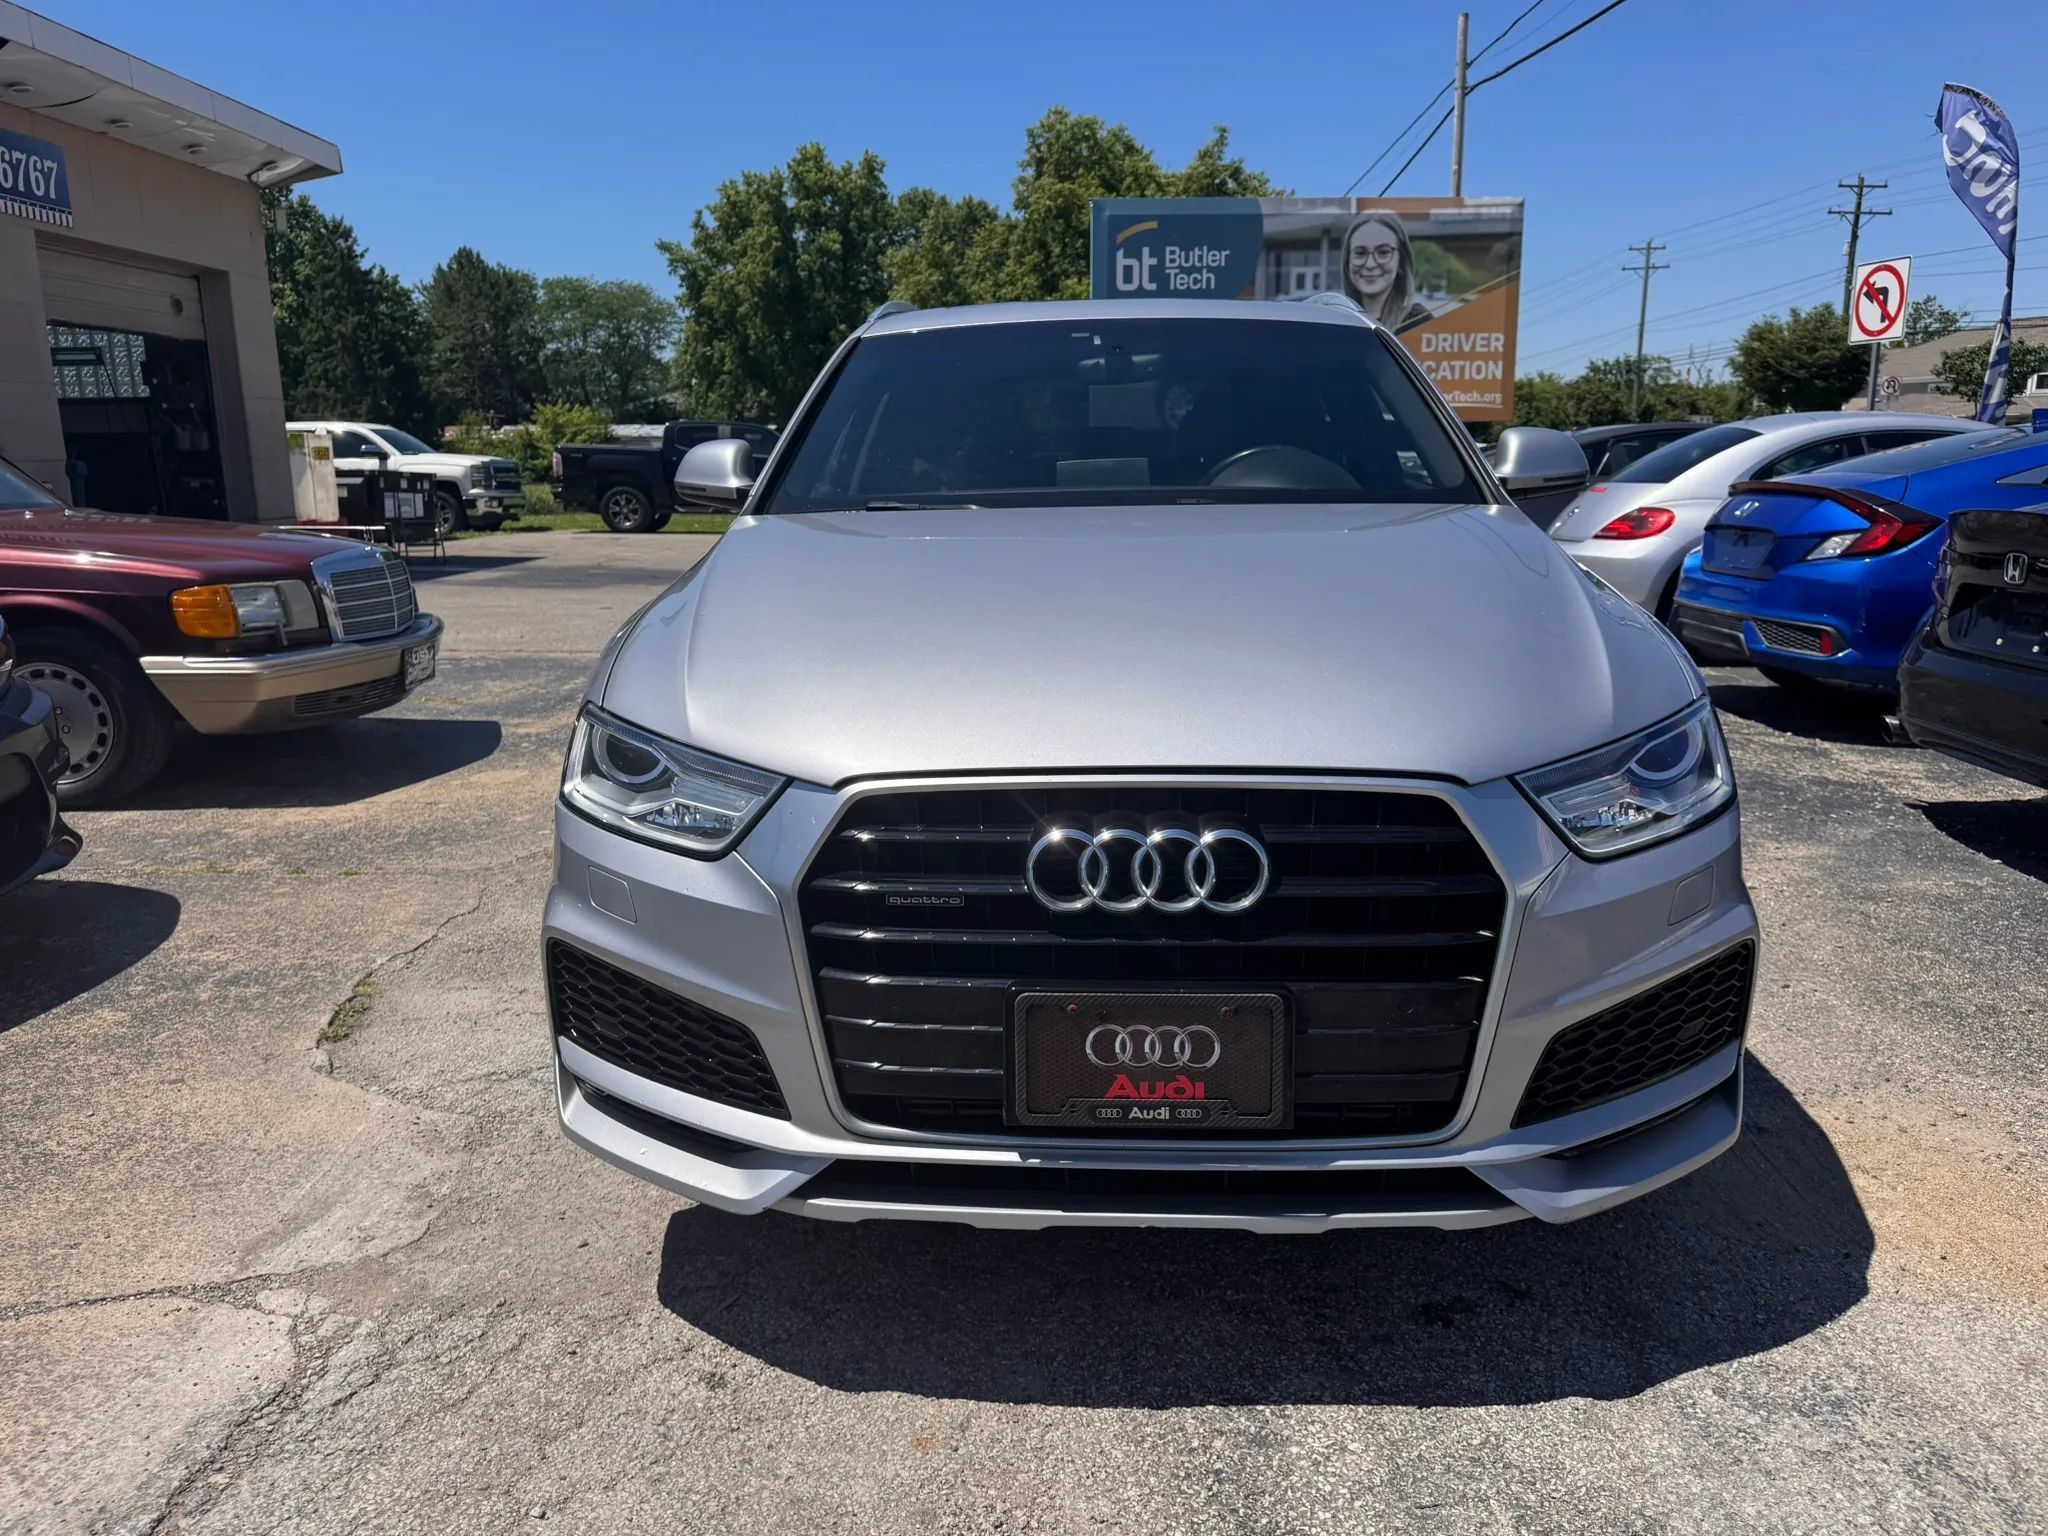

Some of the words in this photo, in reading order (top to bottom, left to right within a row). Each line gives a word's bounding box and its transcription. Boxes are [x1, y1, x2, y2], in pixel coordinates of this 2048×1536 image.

[1165, 245, 1230, 268] Butler
[1116, 246, 1158, 291] bt
[1165, 268, 1216, 290] Tech
[1421, 332, 1504, 353] DRIVER
[889, 896, 961, 905] quattro
[1105, 1073, 1205, 1101] Audi
[1128, 1106, 1170, 1119] Audi
